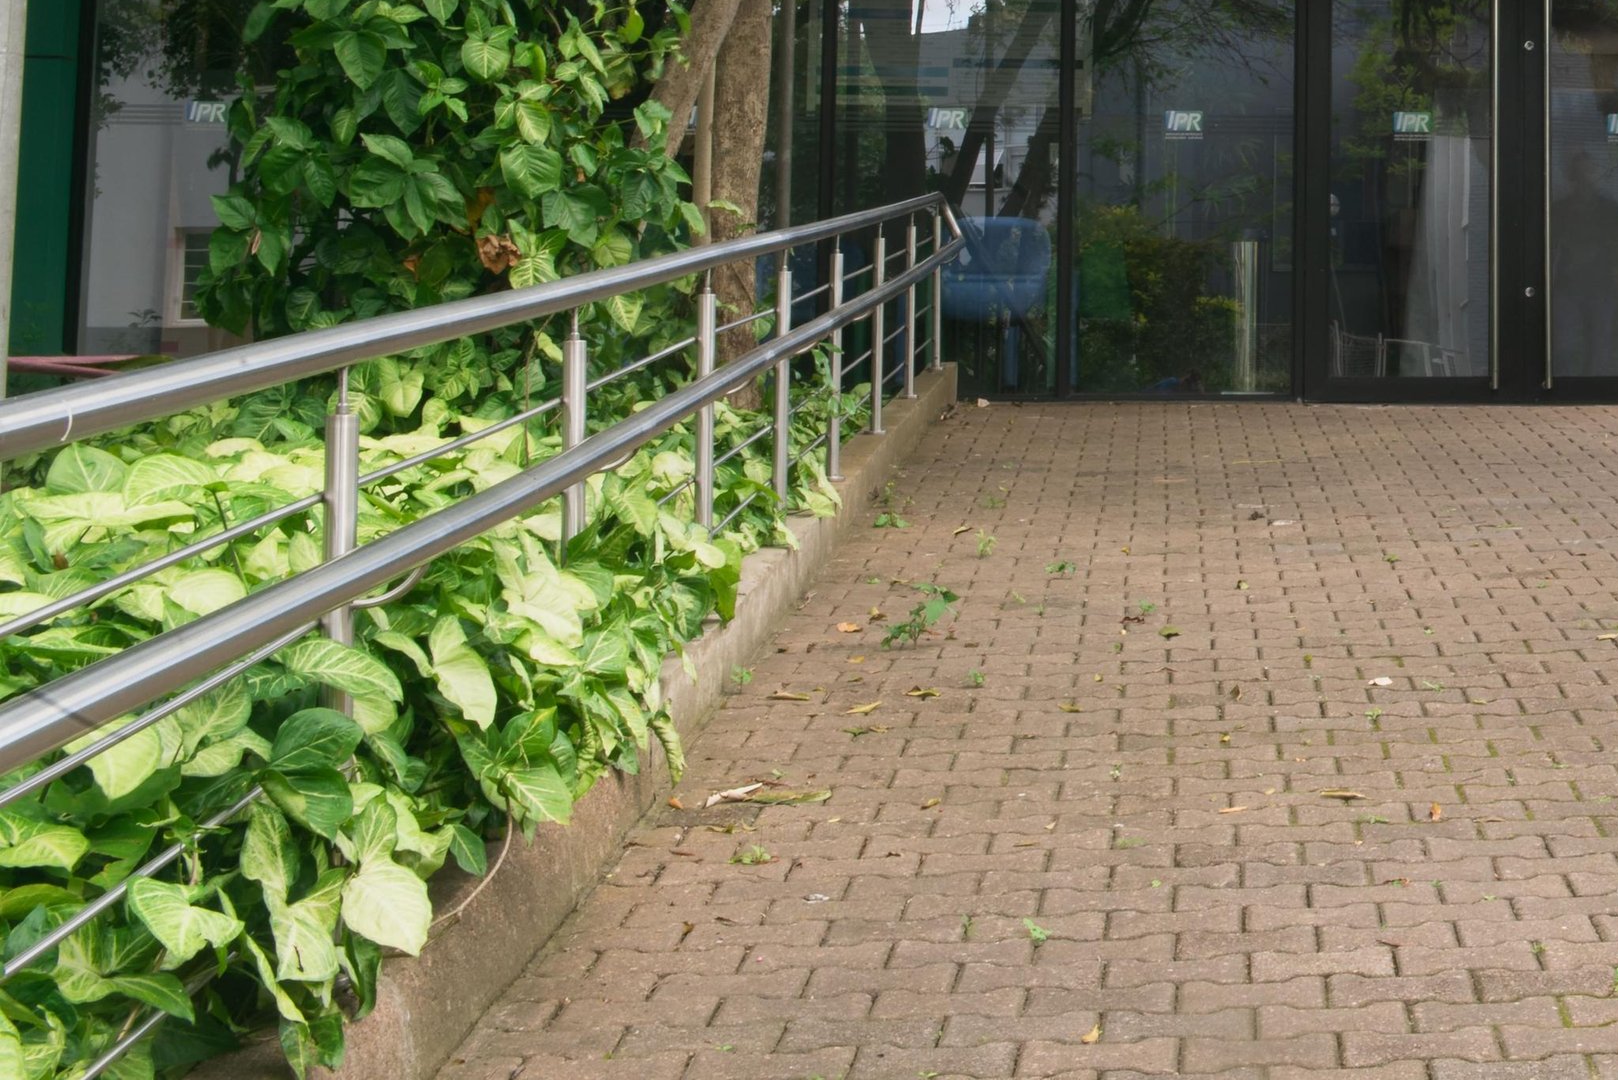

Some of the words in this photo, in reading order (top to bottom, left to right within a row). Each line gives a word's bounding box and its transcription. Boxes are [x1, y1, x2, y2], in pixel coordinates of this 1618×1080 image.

[189, 101, 226, 122] IPR
[930, 107, 965, 128] IPR
[1168, 110, 1201, 131] IPR
[1396, 111, 1429, 132] IPR
